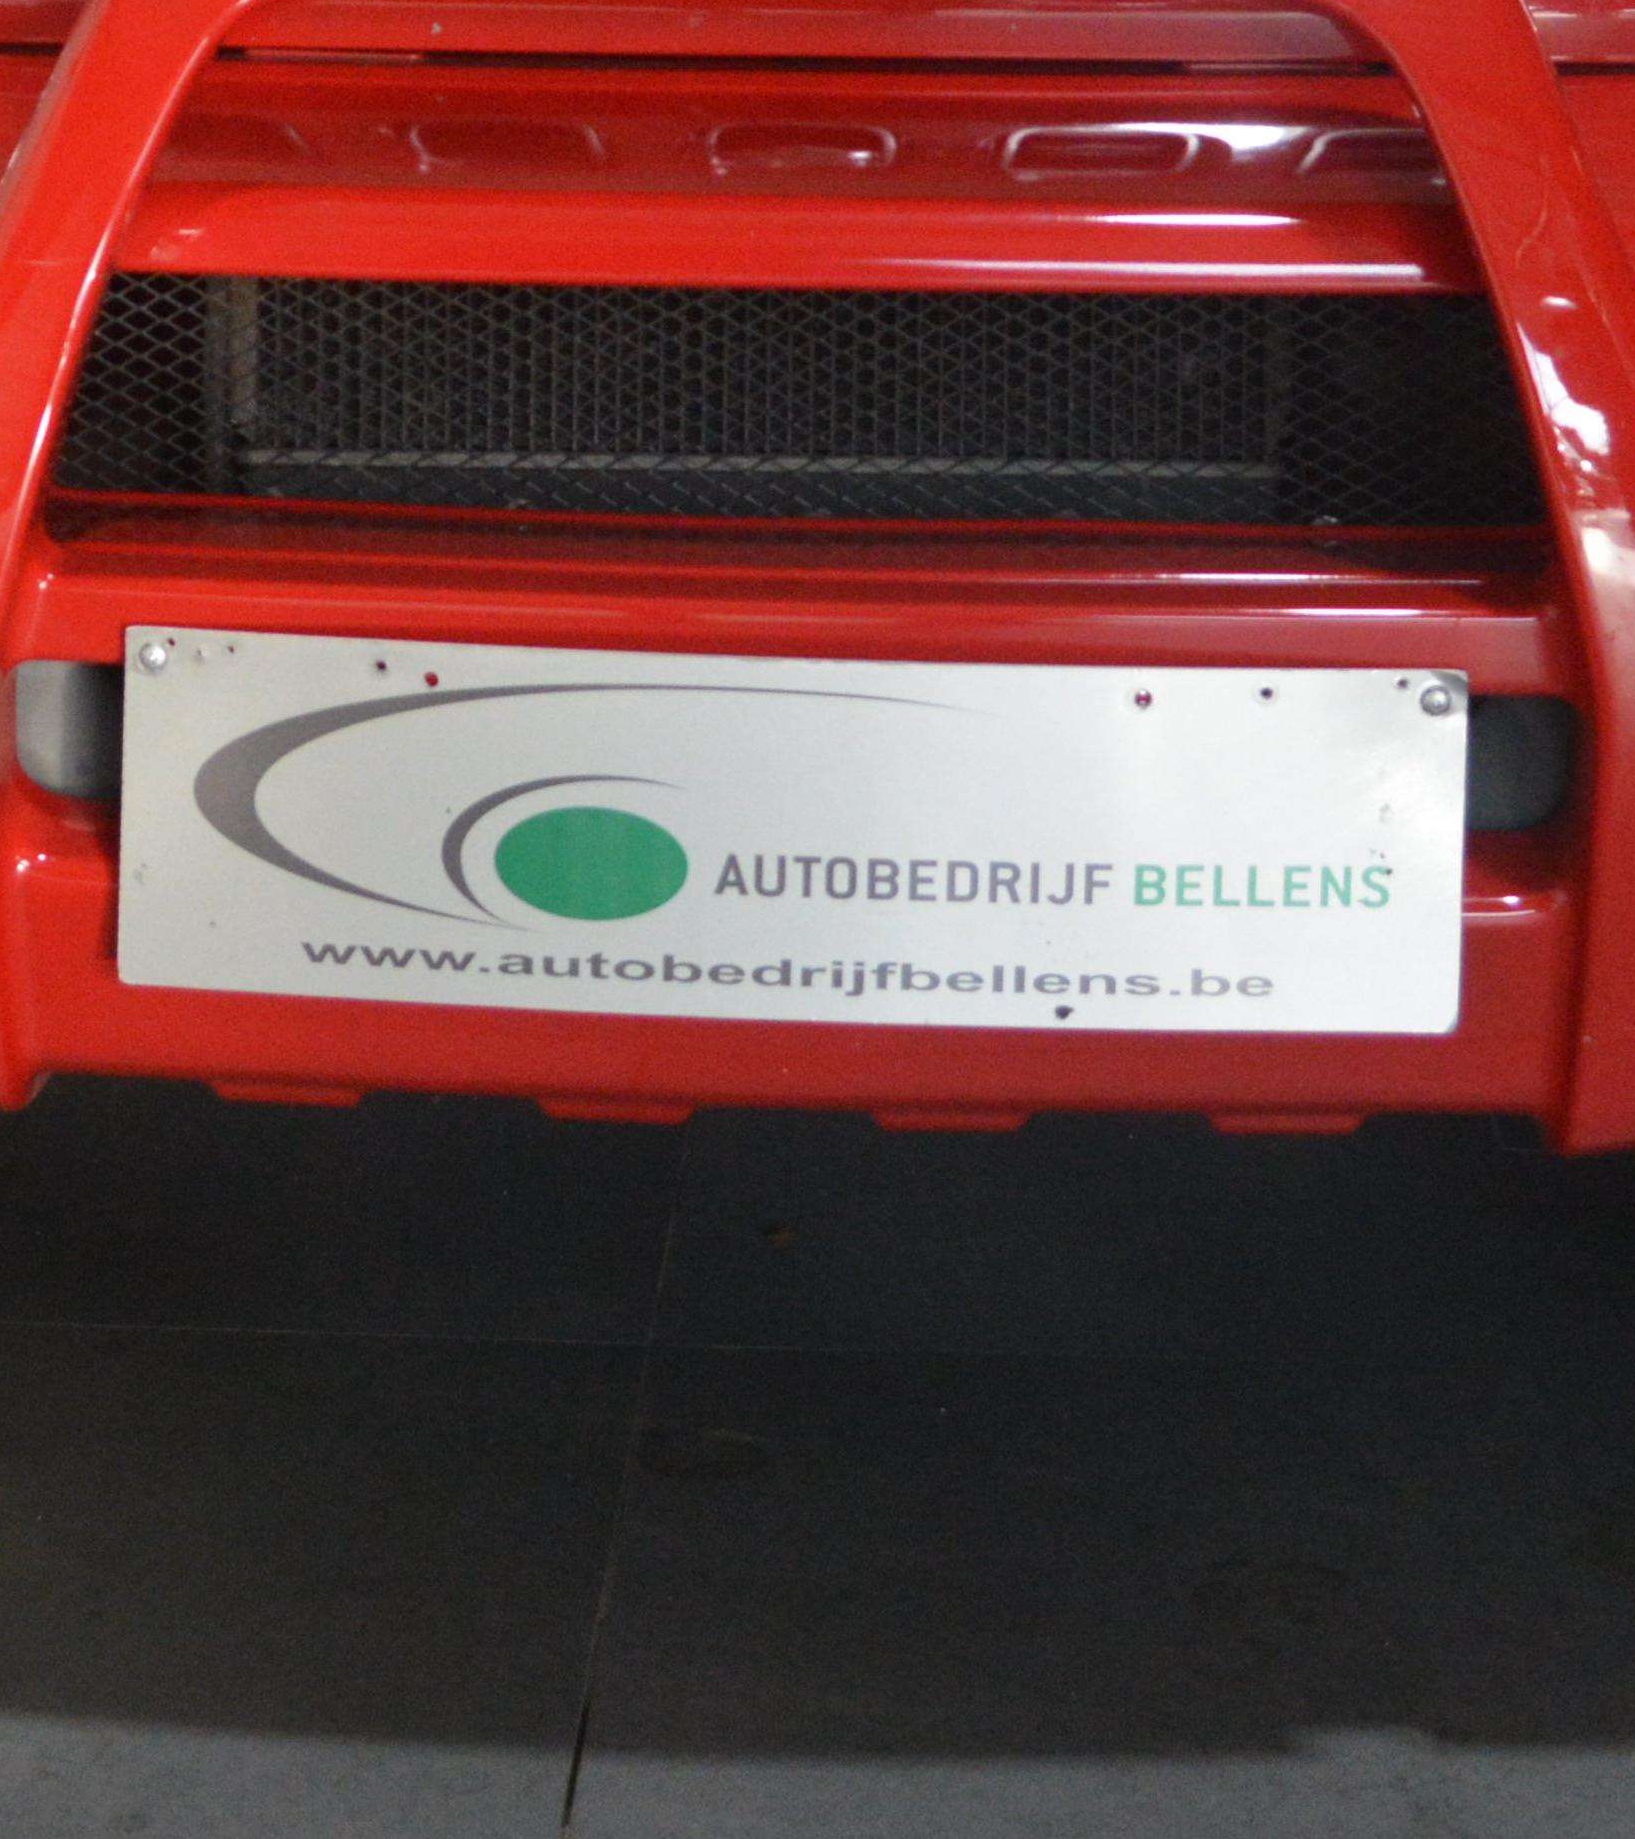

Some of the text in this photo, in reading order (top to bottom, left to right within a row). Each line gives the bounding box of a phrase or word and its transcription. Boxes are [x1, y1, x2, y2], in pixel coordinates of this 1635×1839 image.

[713, 853, 1391, 909] AUTOBEDRIJF BELLENS
[301, 940, 1274, 999] www.autobedrijfbellens.be
